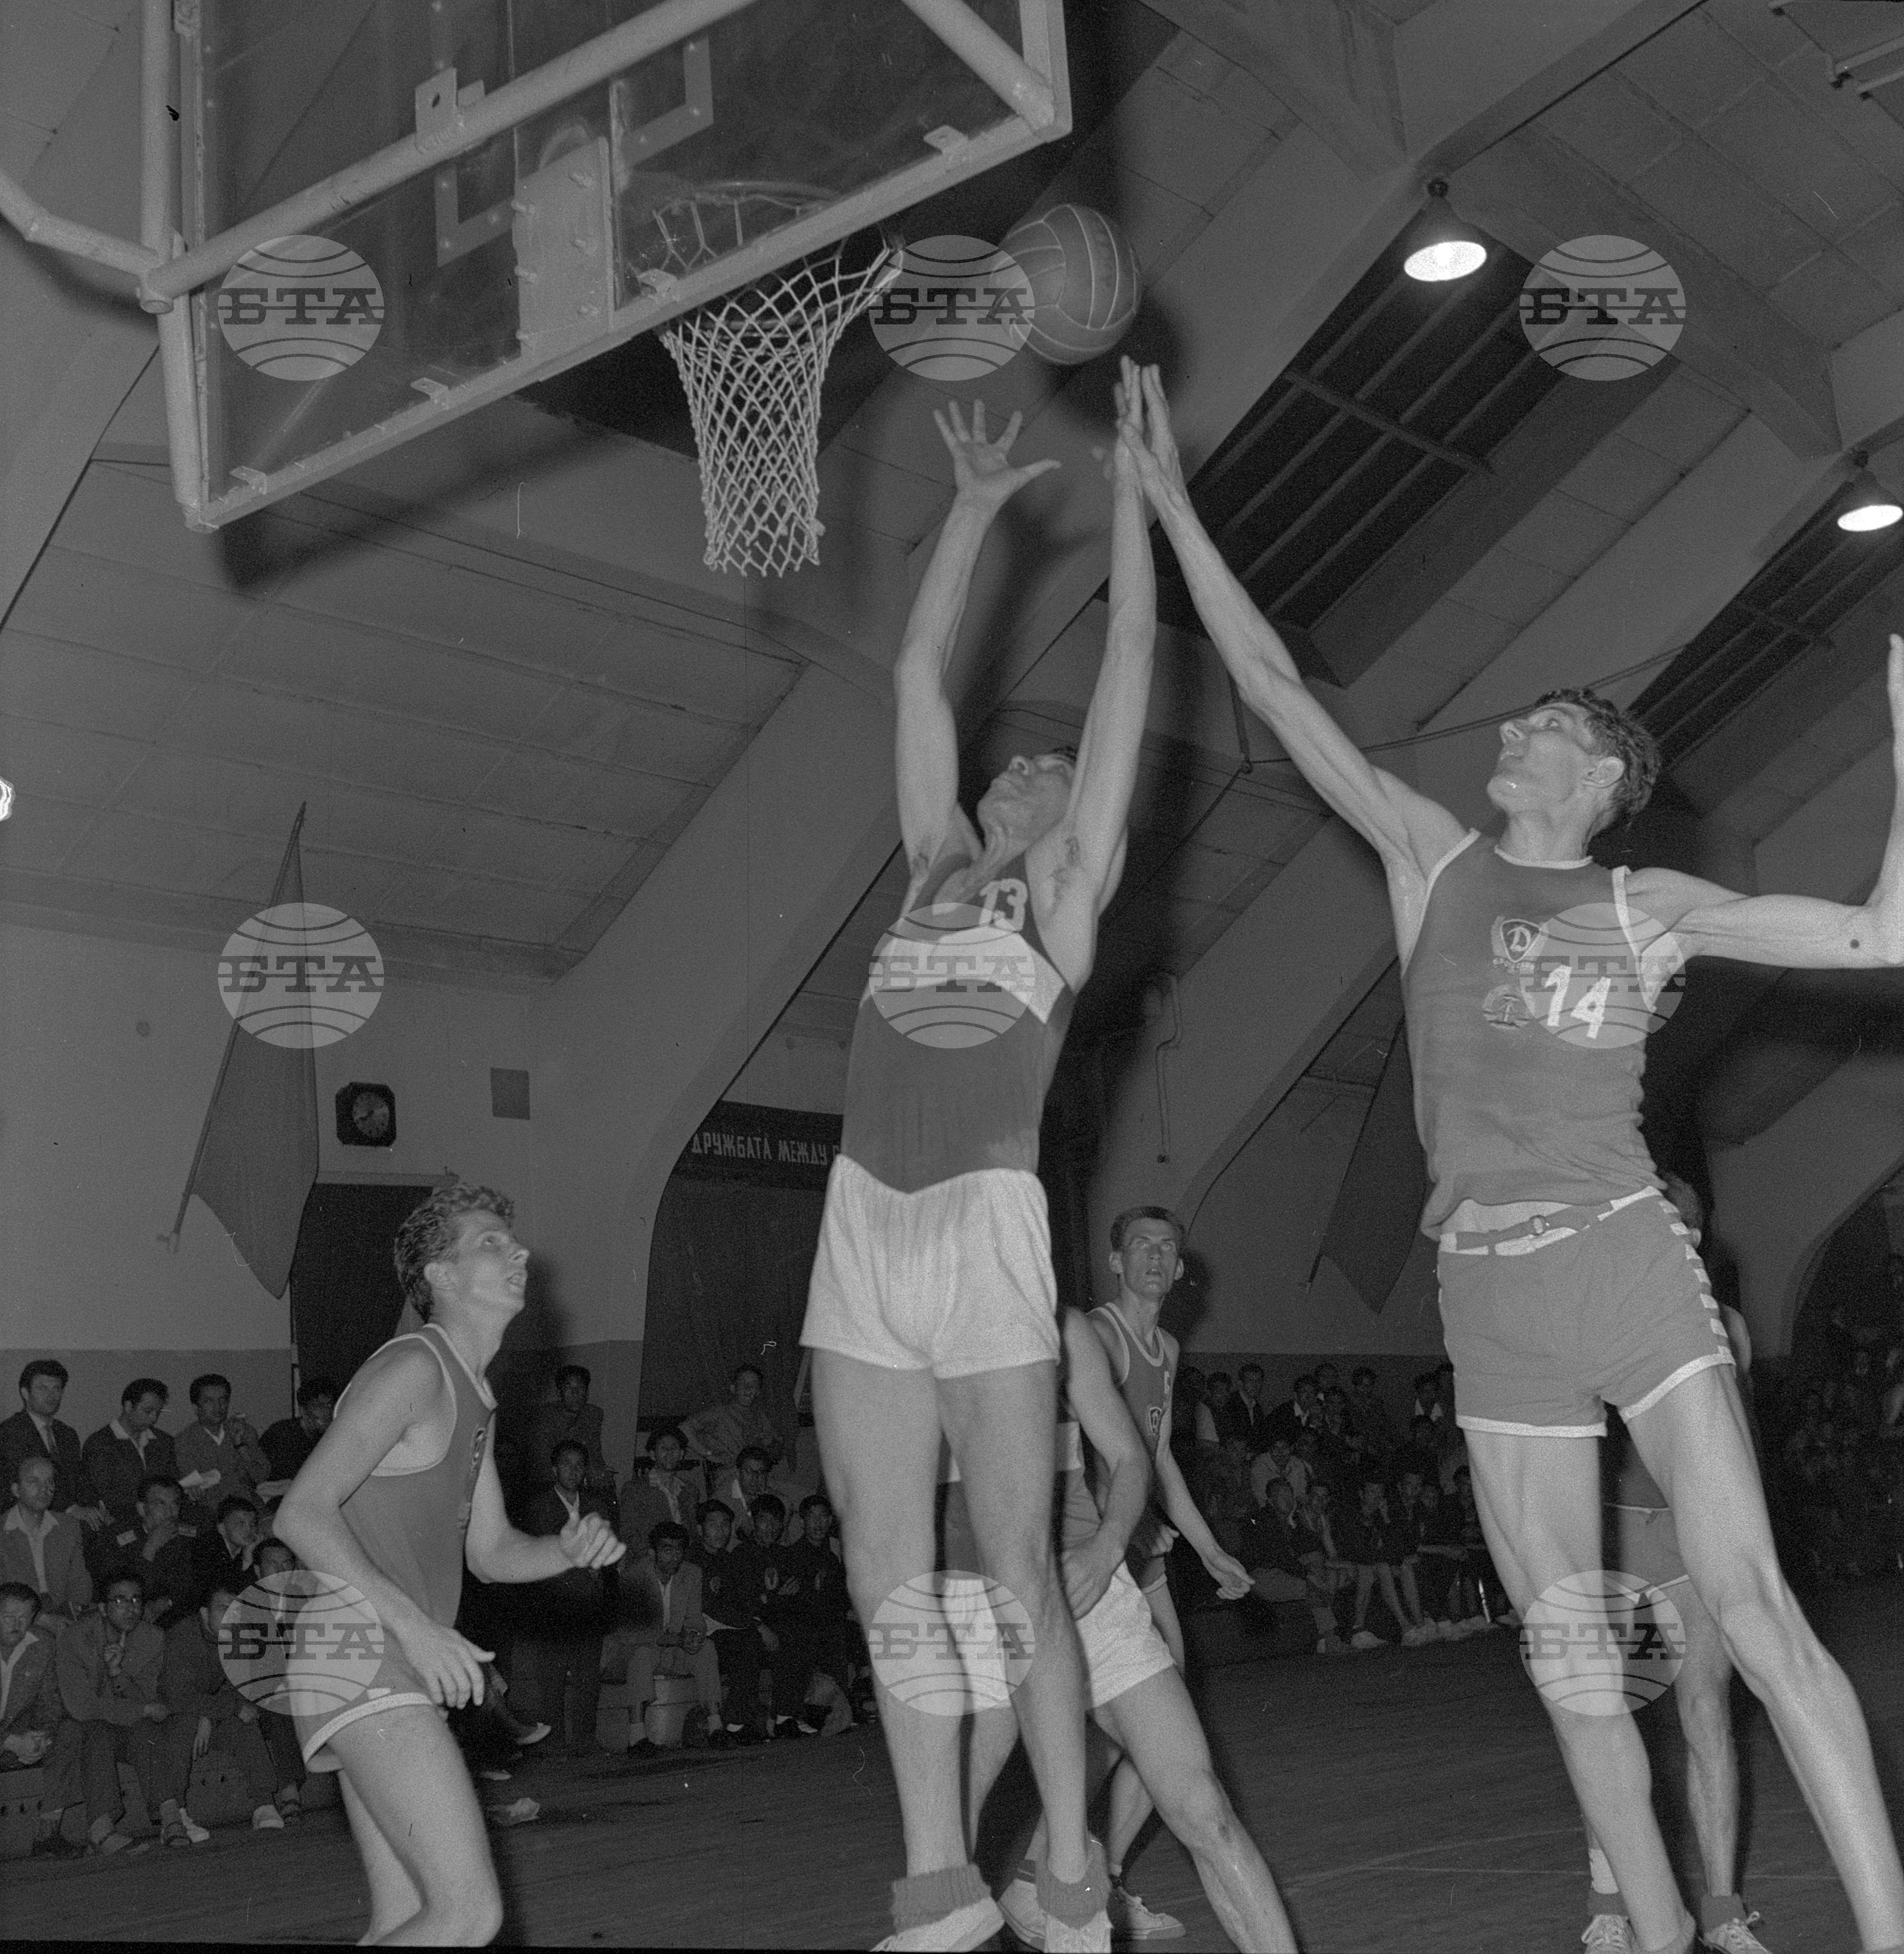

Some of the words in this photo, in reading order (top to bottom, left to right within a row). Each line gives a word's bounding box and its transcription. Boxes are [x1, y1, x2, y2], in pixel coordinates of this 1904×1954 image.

[980, 878, 1028, 932] 13
[1543, 964, 1611, 1039] 14
[692, 1131, 772, 1160] ДРУЖБАТА
[778, 1139, 828, 1166] МЕЖДУ
